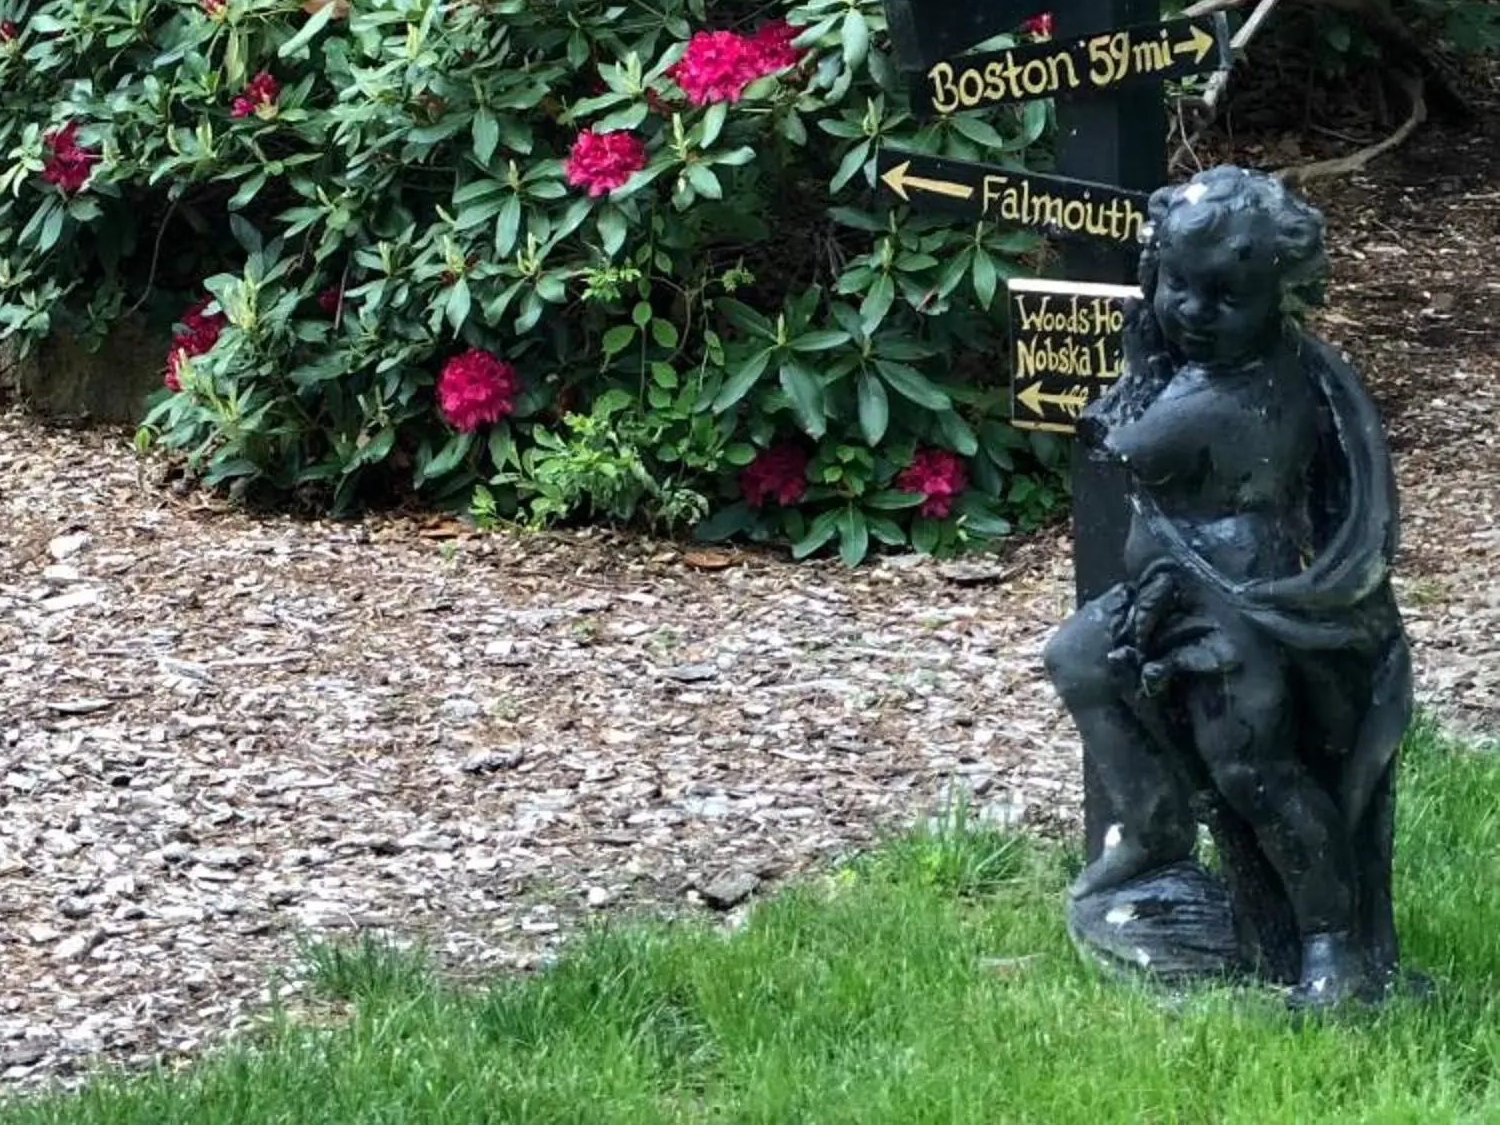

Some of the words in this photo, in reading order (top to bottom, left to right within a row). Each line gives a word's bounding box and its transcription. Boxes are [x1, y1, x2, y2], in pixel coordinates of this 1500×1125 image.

[929, 51, 1080, 113] Boston
[1087, 32, 1130, 86] 59
[1132, 29, 1175, 73] mi
[981, 175, 1146, 241] Falmouth
[1091, 296, 1124, 335] Ho
[1015, 334, 1093, 379] Nobska
